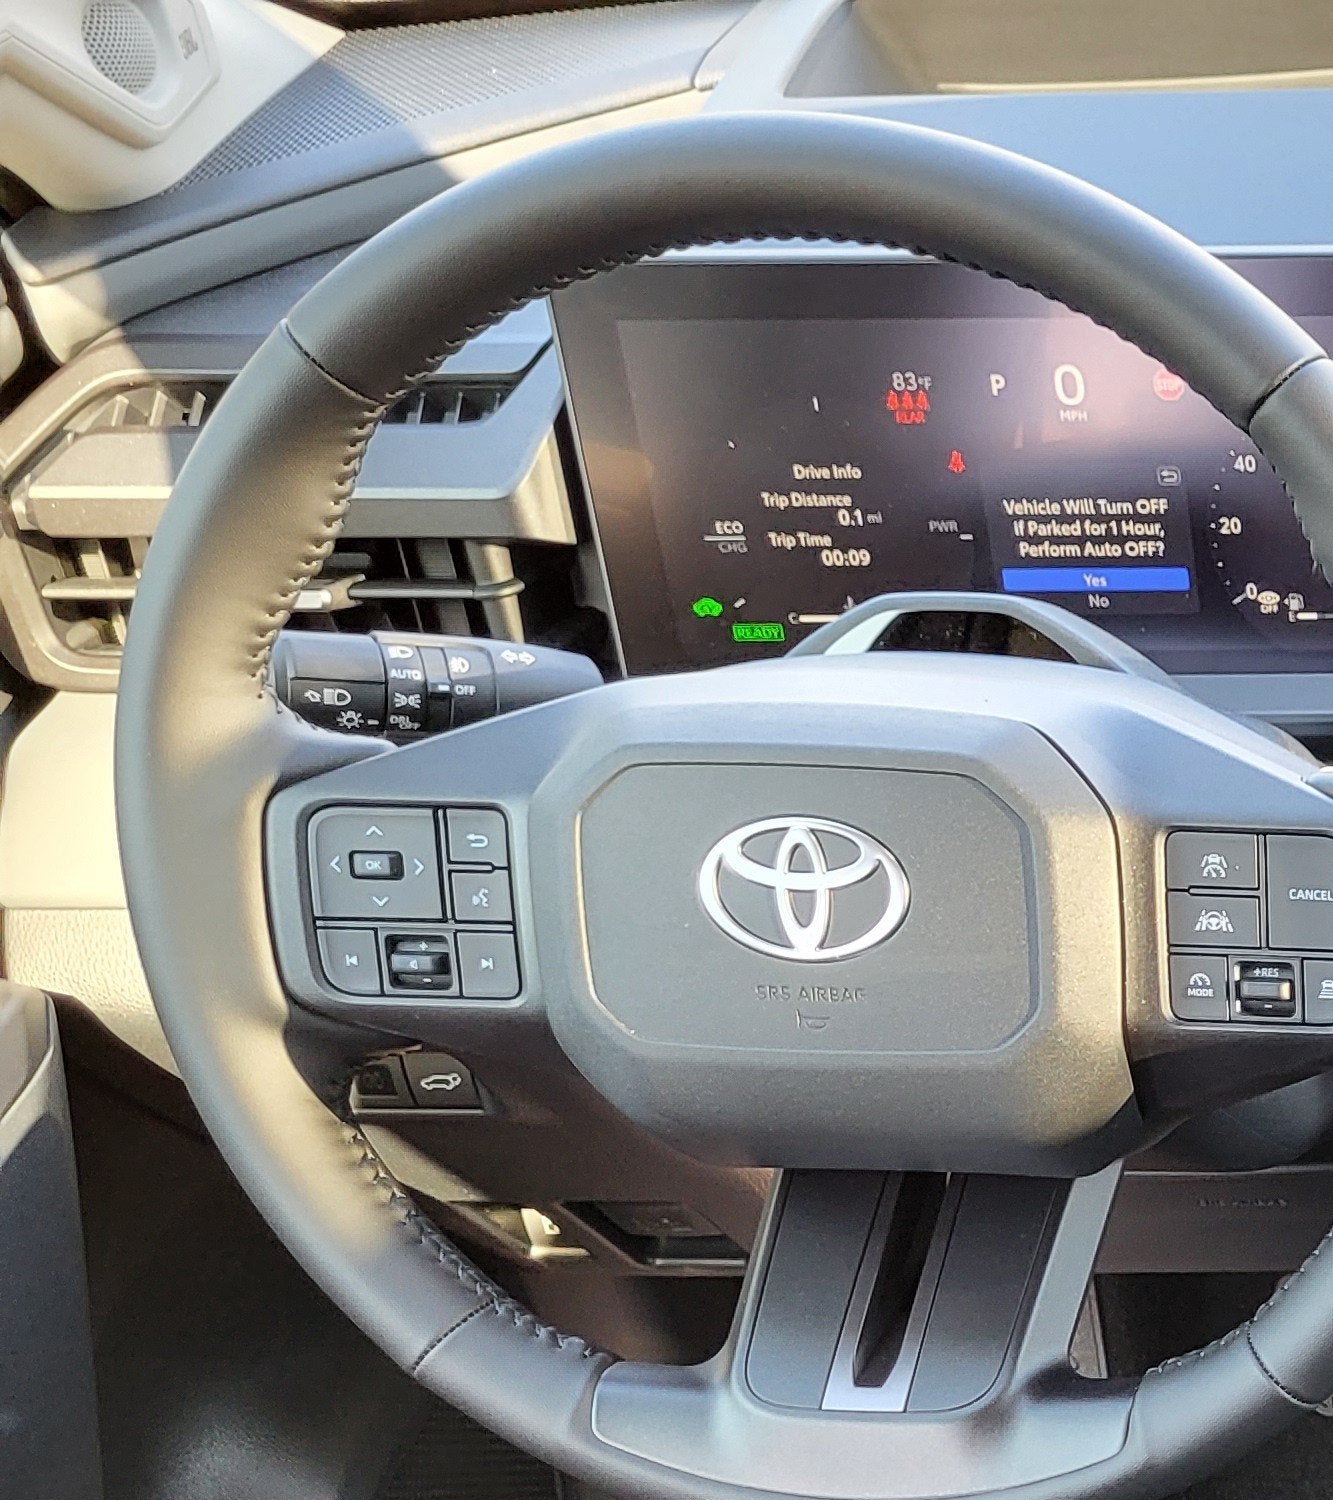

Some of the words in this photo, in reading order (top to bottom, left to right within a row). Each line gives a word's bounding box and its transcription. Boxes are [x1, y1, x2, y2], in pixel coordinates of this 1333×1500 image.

[989, 374, 1006, 396] P
[1054, 363, 1085, 406] 0
[1060, 409, 1088, 422] MPH
[792, 463, 831, 480] Drive
[832, 463, 862, 480] Info
[1233, 454, 1257, 473] 40
[760, 491, 789, 510] Trip
[790, 491, 852, 508] Distance
[1002, 498, 1061, 516] Vehicle
[1062, 498, 1096, 515] Will
[1097, 498, 1133, 515] Turn
[1135, 498, 1169, 515] OFF
[837, 508, 863, 527] 0.1
[1217, 516, 1242, 535] 20
[714, 520, 744, 534] ECO
[928, 520, 959, 533] PWR
[1027, 520, 1082, 536] Parked
[1084, 520, 1107, 536] for
[1108, 520, 1119, 536] 1
[1121, 520, 1166, 538] Hour,
[767, 531, 796, 550] Trip
[797, 532, 832, 547] Time
[1019, 541, 1082, 558] Perform
[1083, 541, 1123, 557] Auto
[1124, 541, 1166, 557] OFF?
[820, 550, 871, 567] 00:09
[1082, 573, 1108, 588] Yes
[1088, 594, 1111, 609] No
[735, 626, 780, 639] READY
[390, 668, 422, 681] AUTO
[455, 684, 477, 697] OFF
[365, 859, 382, 872] OK
[1289, 888, 1333, 902] CANCEL
[1187, 987, 1214, 997] MODE
